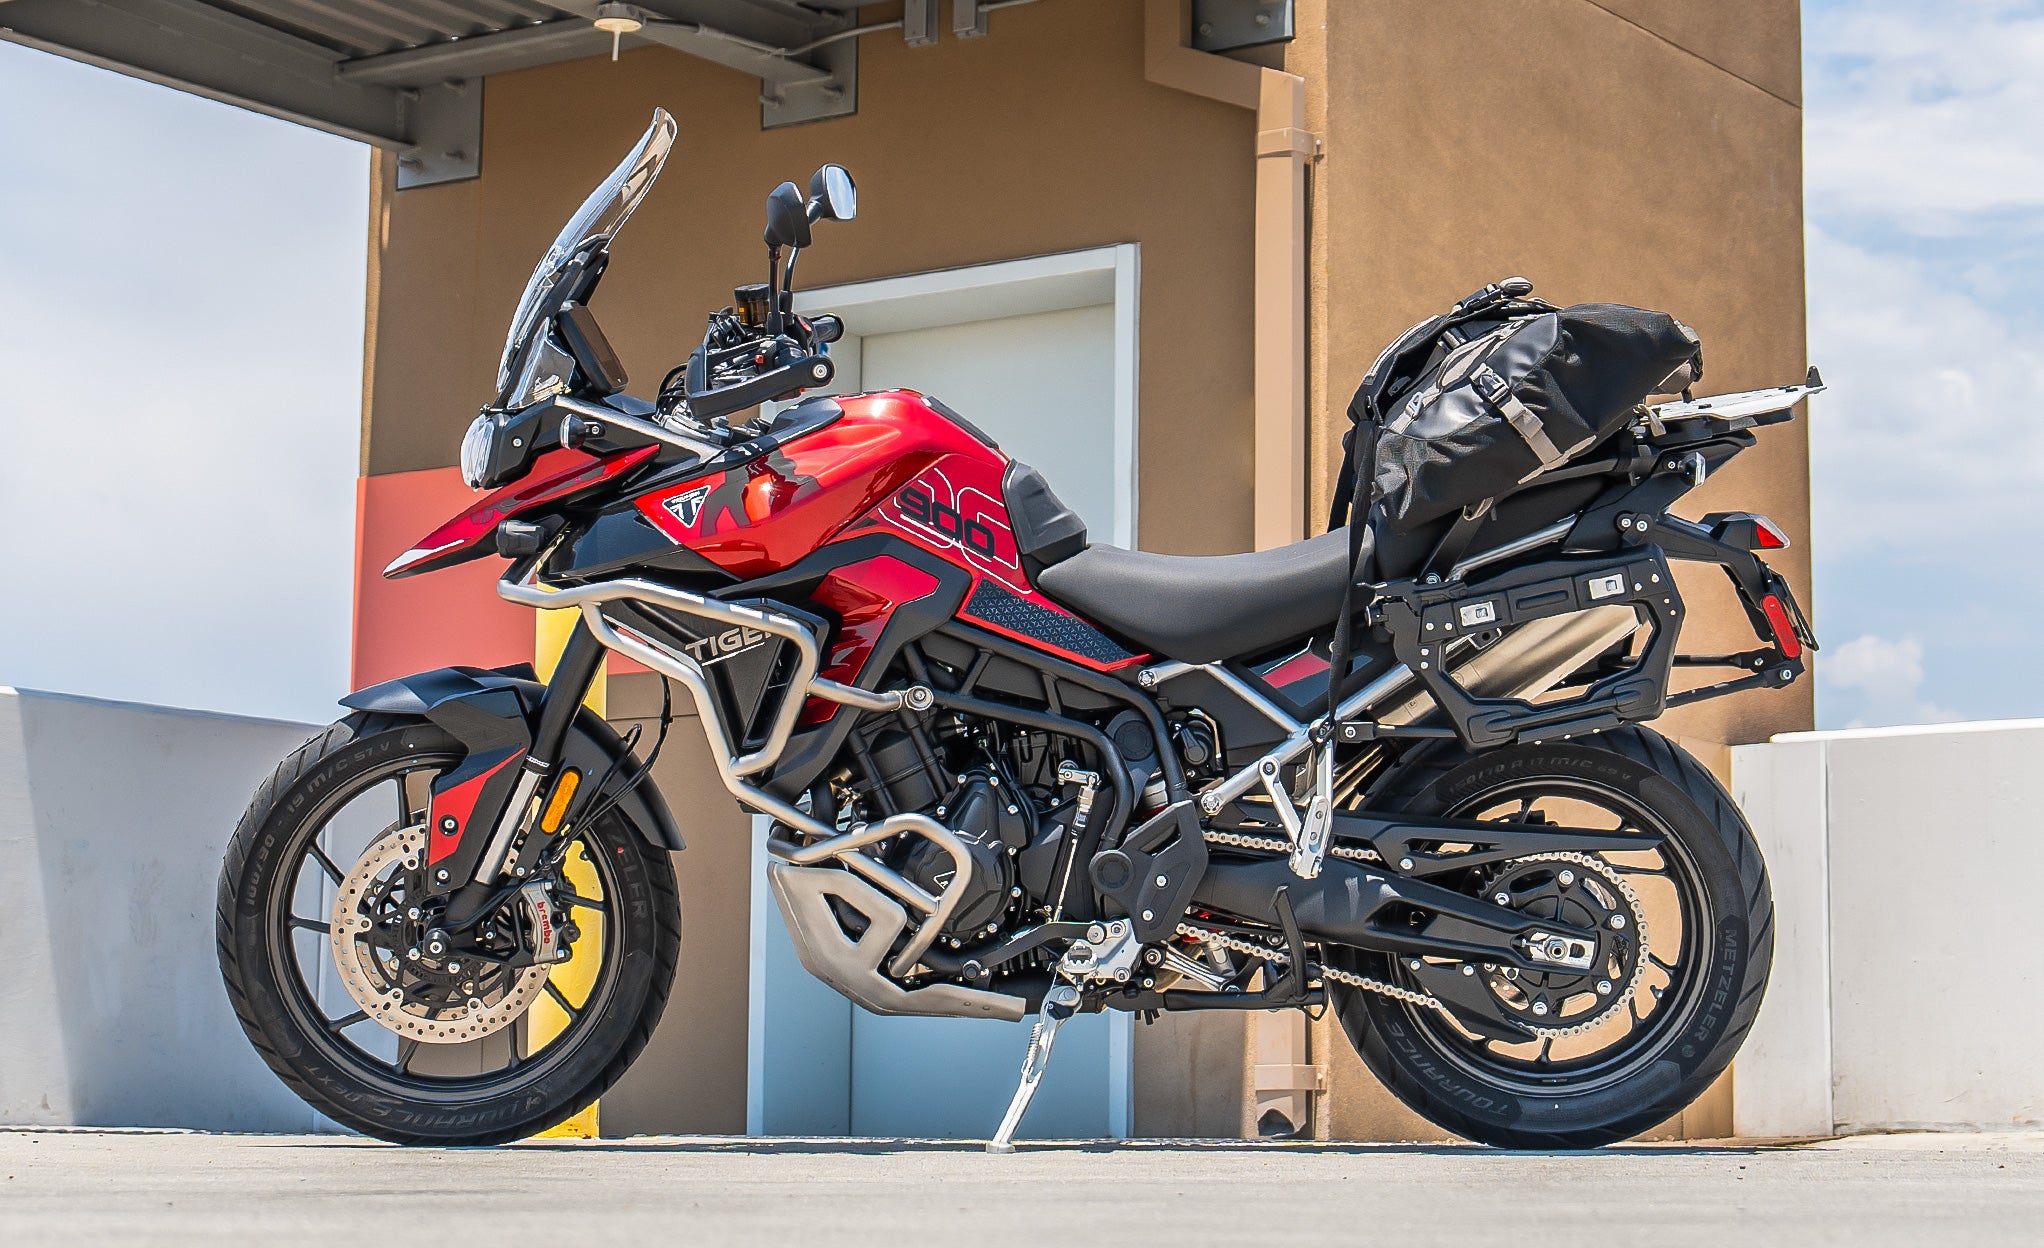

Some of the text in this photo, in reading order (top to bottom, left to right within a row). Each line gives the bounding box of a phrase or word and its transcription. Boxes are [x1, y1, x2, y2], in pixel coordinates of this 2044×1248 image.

[899, 486, 995, 559] 900
[684, 625, 772, 661] TIGE
[536, 901, 551, 945] brembo
[1694, 929, 1737, 1041] METZELER
[1385, 1021, 1508, 1116] TOURANCE
